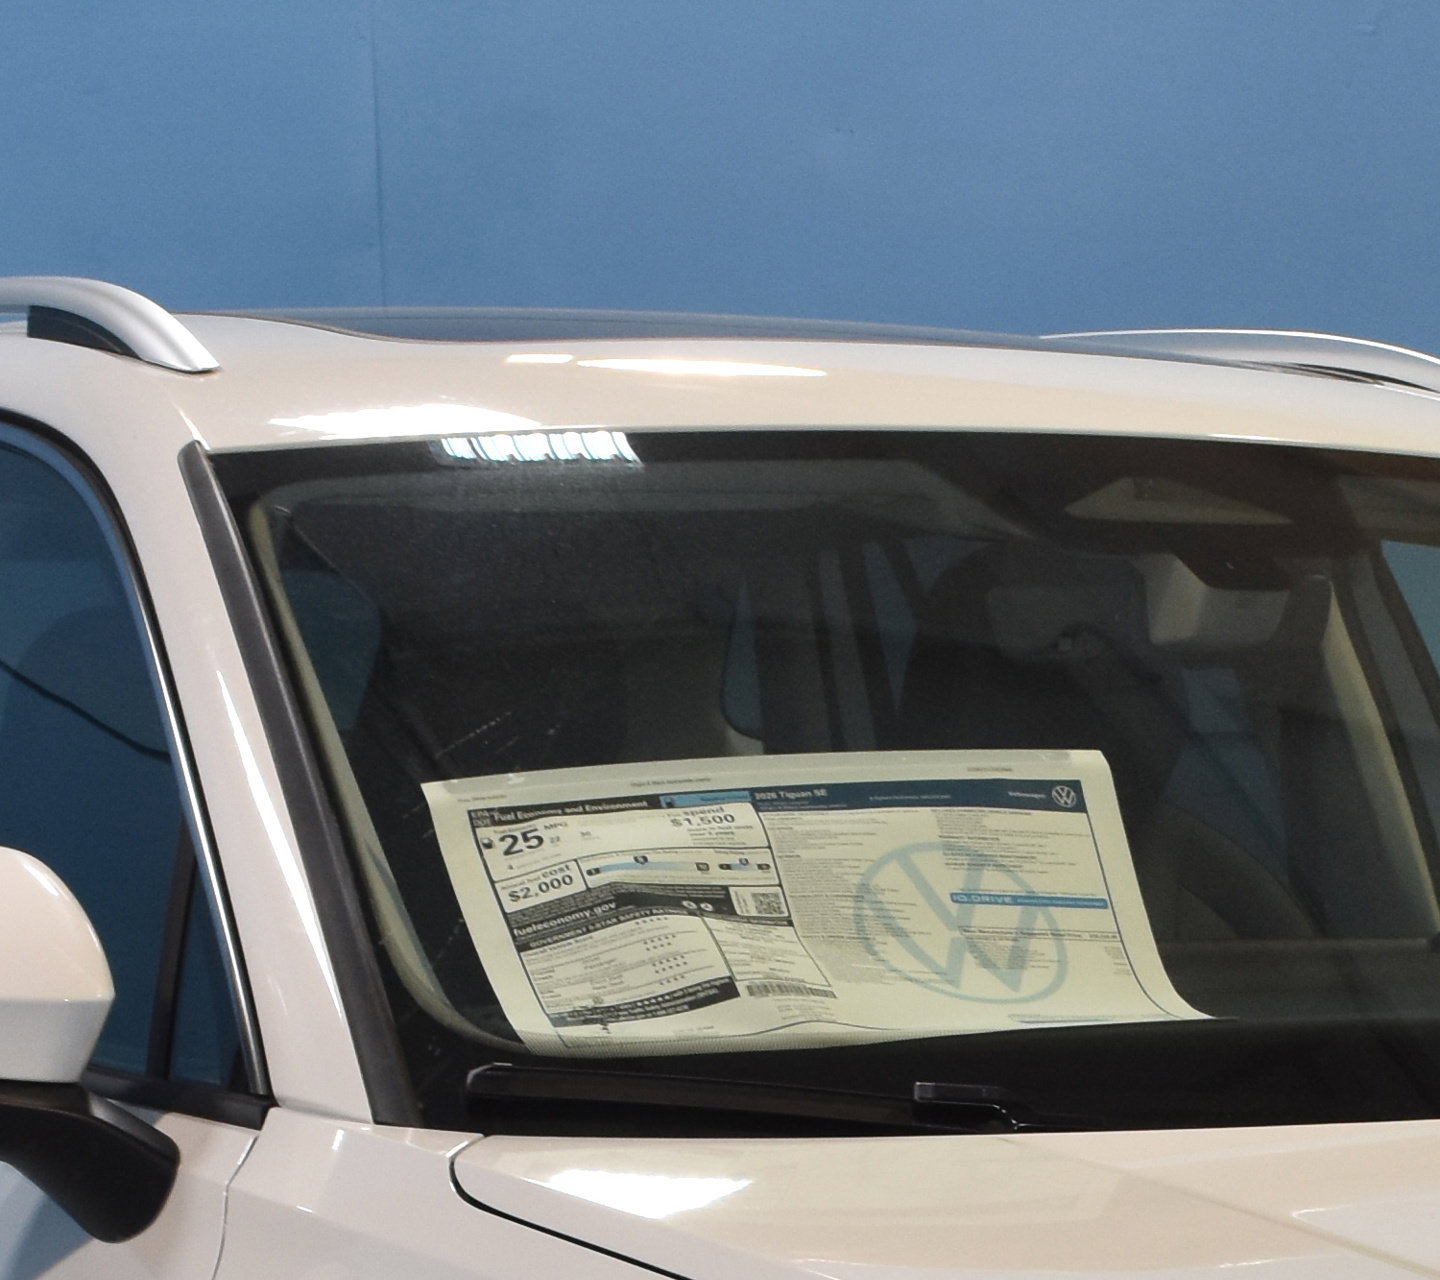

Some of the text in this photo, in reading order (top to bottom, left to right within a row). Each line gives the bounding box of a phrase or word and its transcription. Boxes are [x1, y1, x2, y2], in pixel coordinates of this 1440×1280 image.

[778, 790, 811, 800] Tiguan
[494, 800, 649, 822] Fuel Economy and Environment
[670, 813, 736, 828] $1,500
[543, 821, 569, 831] MPG
[498, 828, 545, 856] 25
[508, 874, 574, 902] $2,000
[513, 901, 617, 937] fueleconomy.gov
